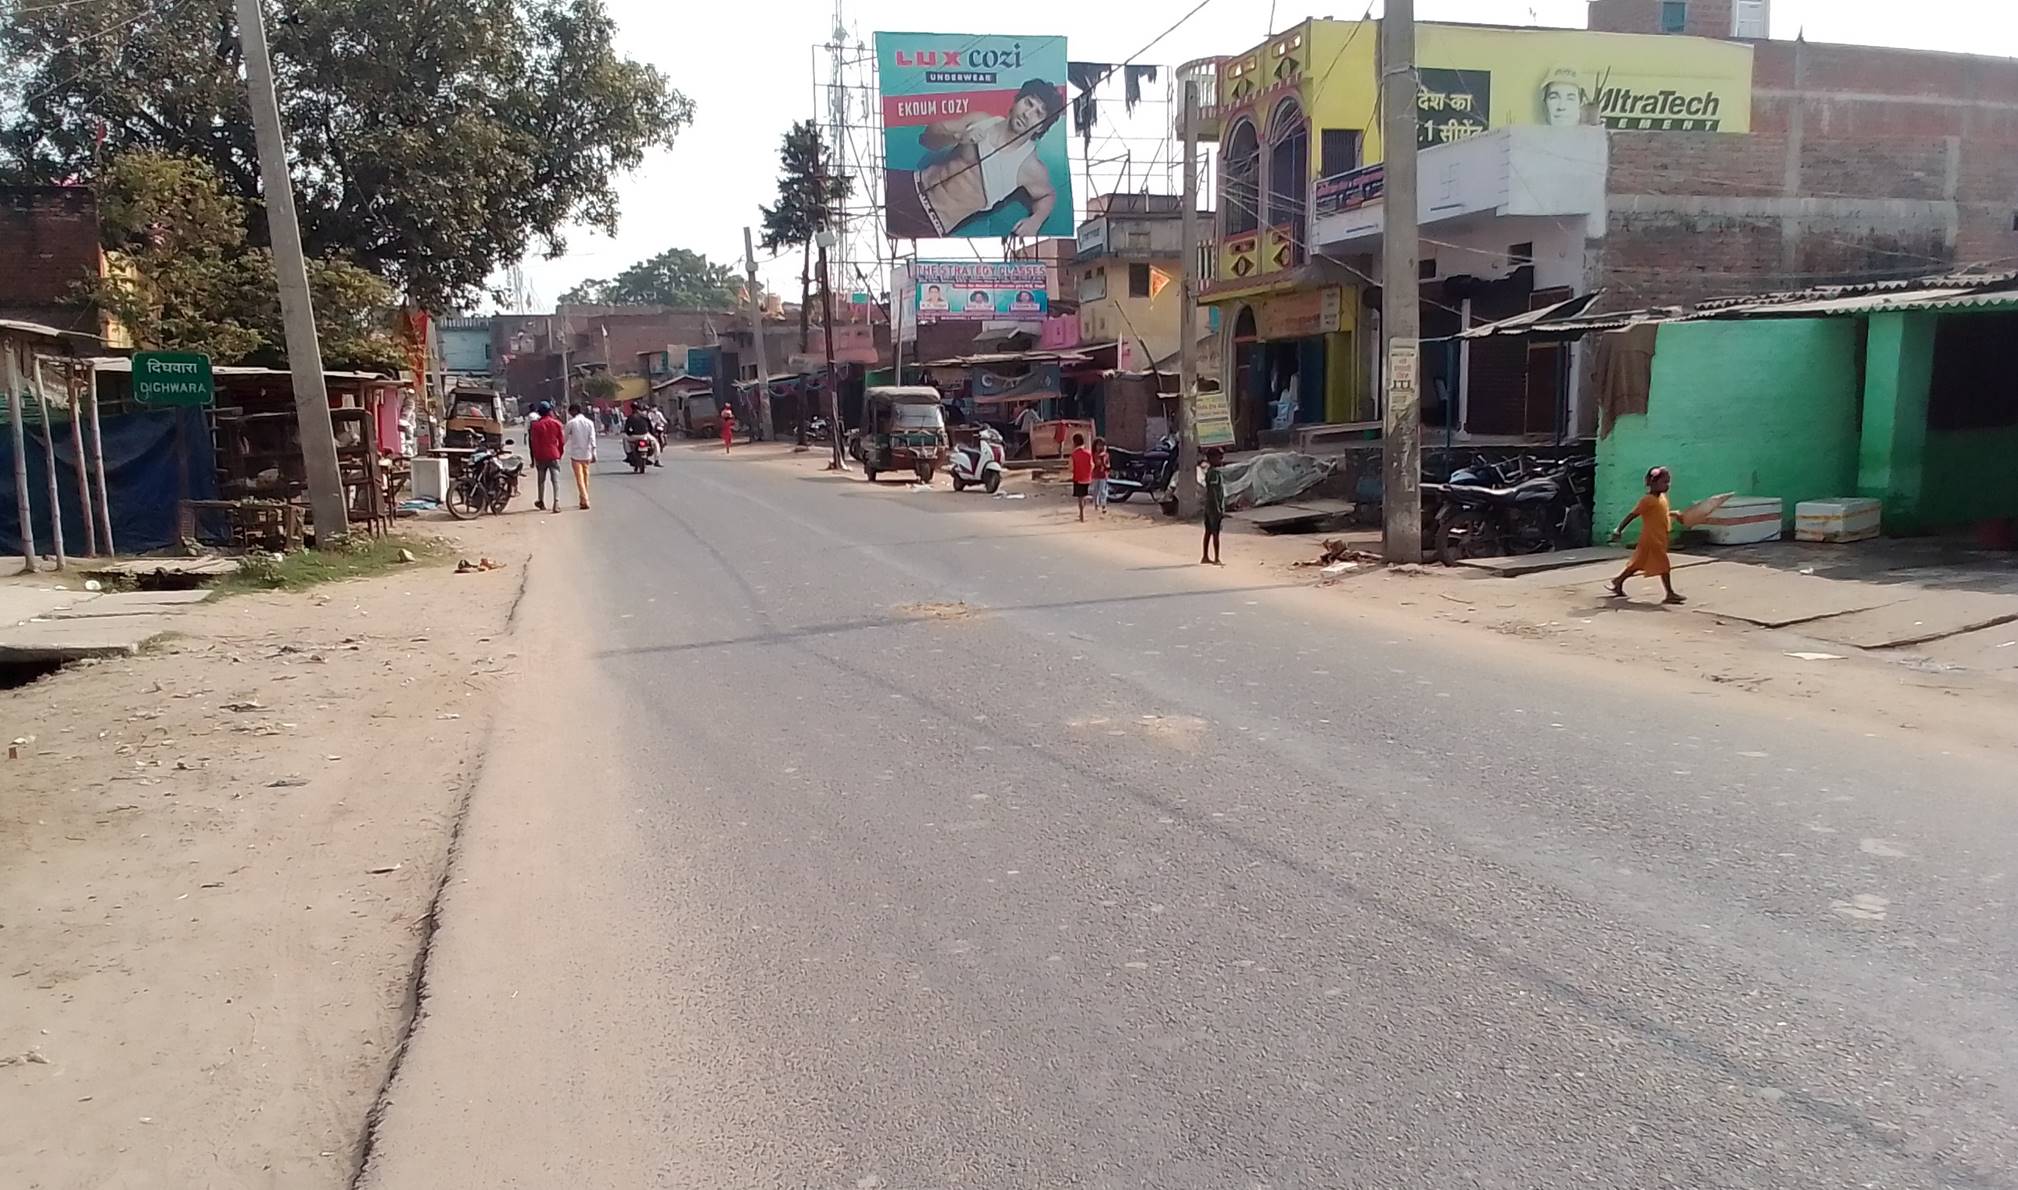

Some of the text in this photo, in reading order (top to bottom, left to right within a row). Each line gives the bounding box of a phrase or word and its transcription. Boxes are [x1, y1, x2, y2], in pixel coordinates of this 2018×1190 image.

[896, 51, 960, 67] LUX
[930, 74, 992, 82] UNDERWEAR
[941, 98, 969, 114] COZY
[1450, 94, 1472, 112] का
[917, 263, 937, 277] THE
[999, 262, 1047, 276] CLASSES
[146, 358, 198, 374] दिघवारा
[140, 382, 206, 393] DIGHWARA
